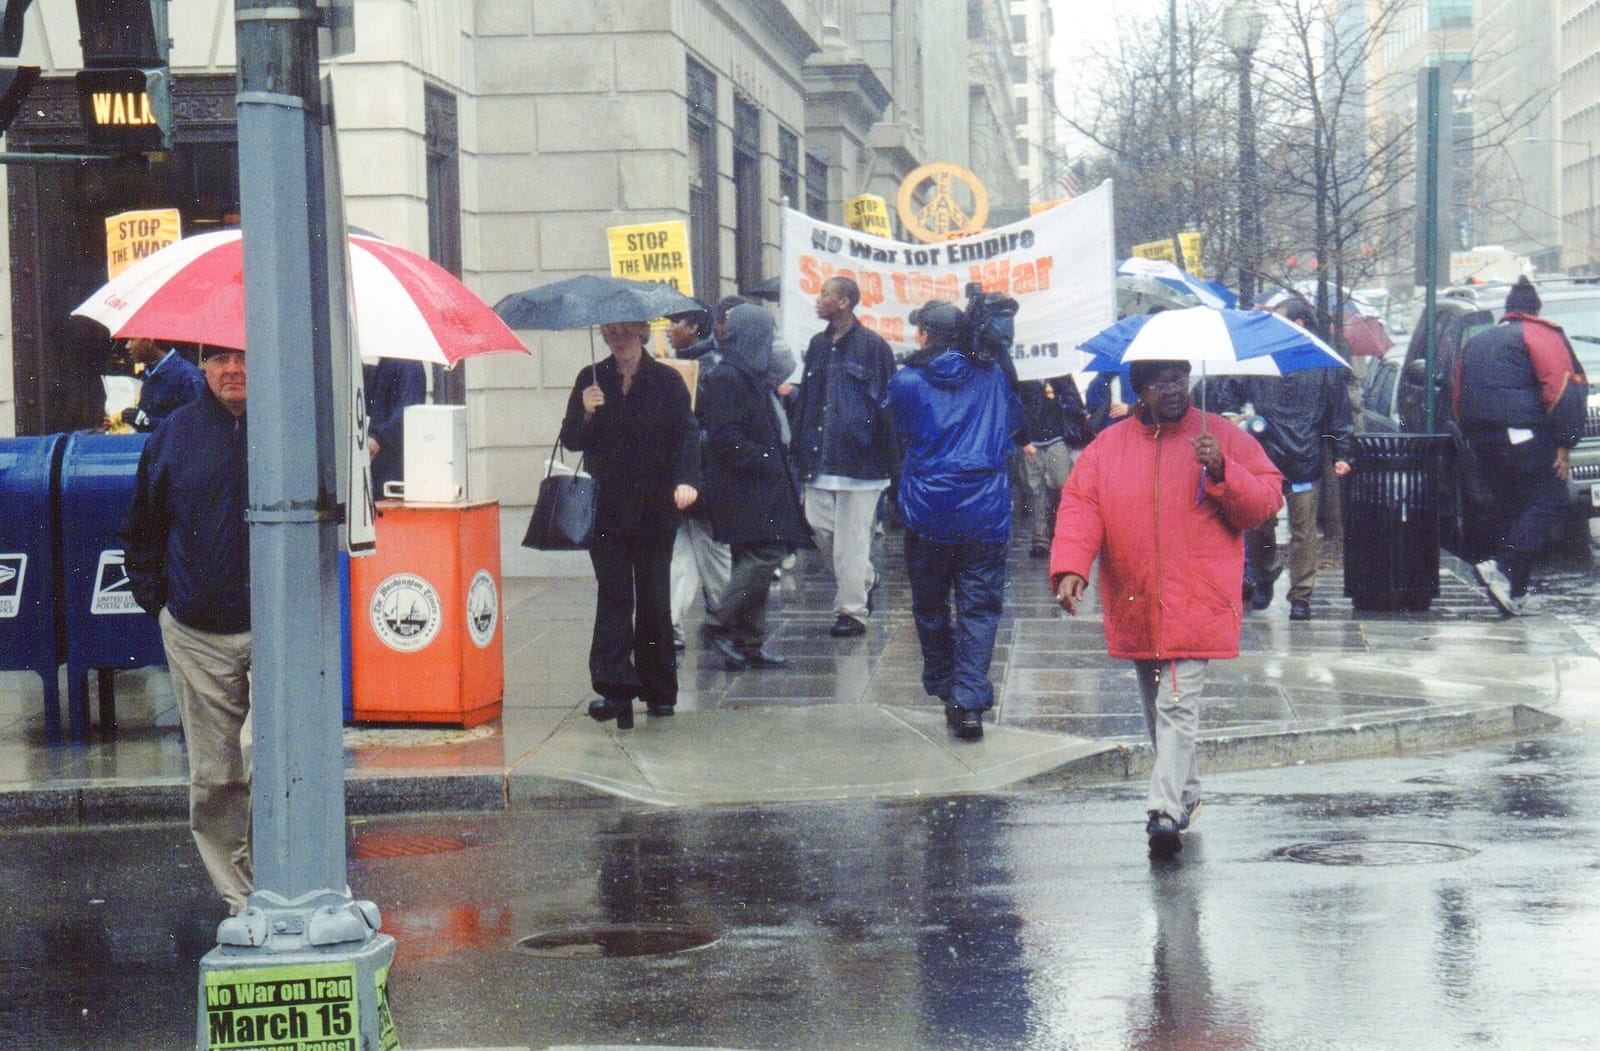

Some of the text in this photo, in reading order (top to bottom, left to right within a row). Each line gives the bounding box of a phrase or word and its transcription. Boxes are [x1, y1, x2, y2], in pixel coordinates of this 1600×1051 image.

[854, 199, 878, 215] STOP
[119, 218, 161, 241] STOP
[627, 231, 668, 252] STOP
[112, 247, 129, 265] THE
[811, 228, 842, 253] No
[850, 239, 897, 264] War
[904, 247, 940, 266] for
[947, 229, 1035, 264] Empire
[618, 251, 683, 275] THE WAR
[891, 270, 961, 305] the
[969, 255, 1054, 296] War
[207, 977, 352, 1006] No War on Iraq
[209, 1006, 309, 1045] March
[316, 1002, 353, 1037] 15
